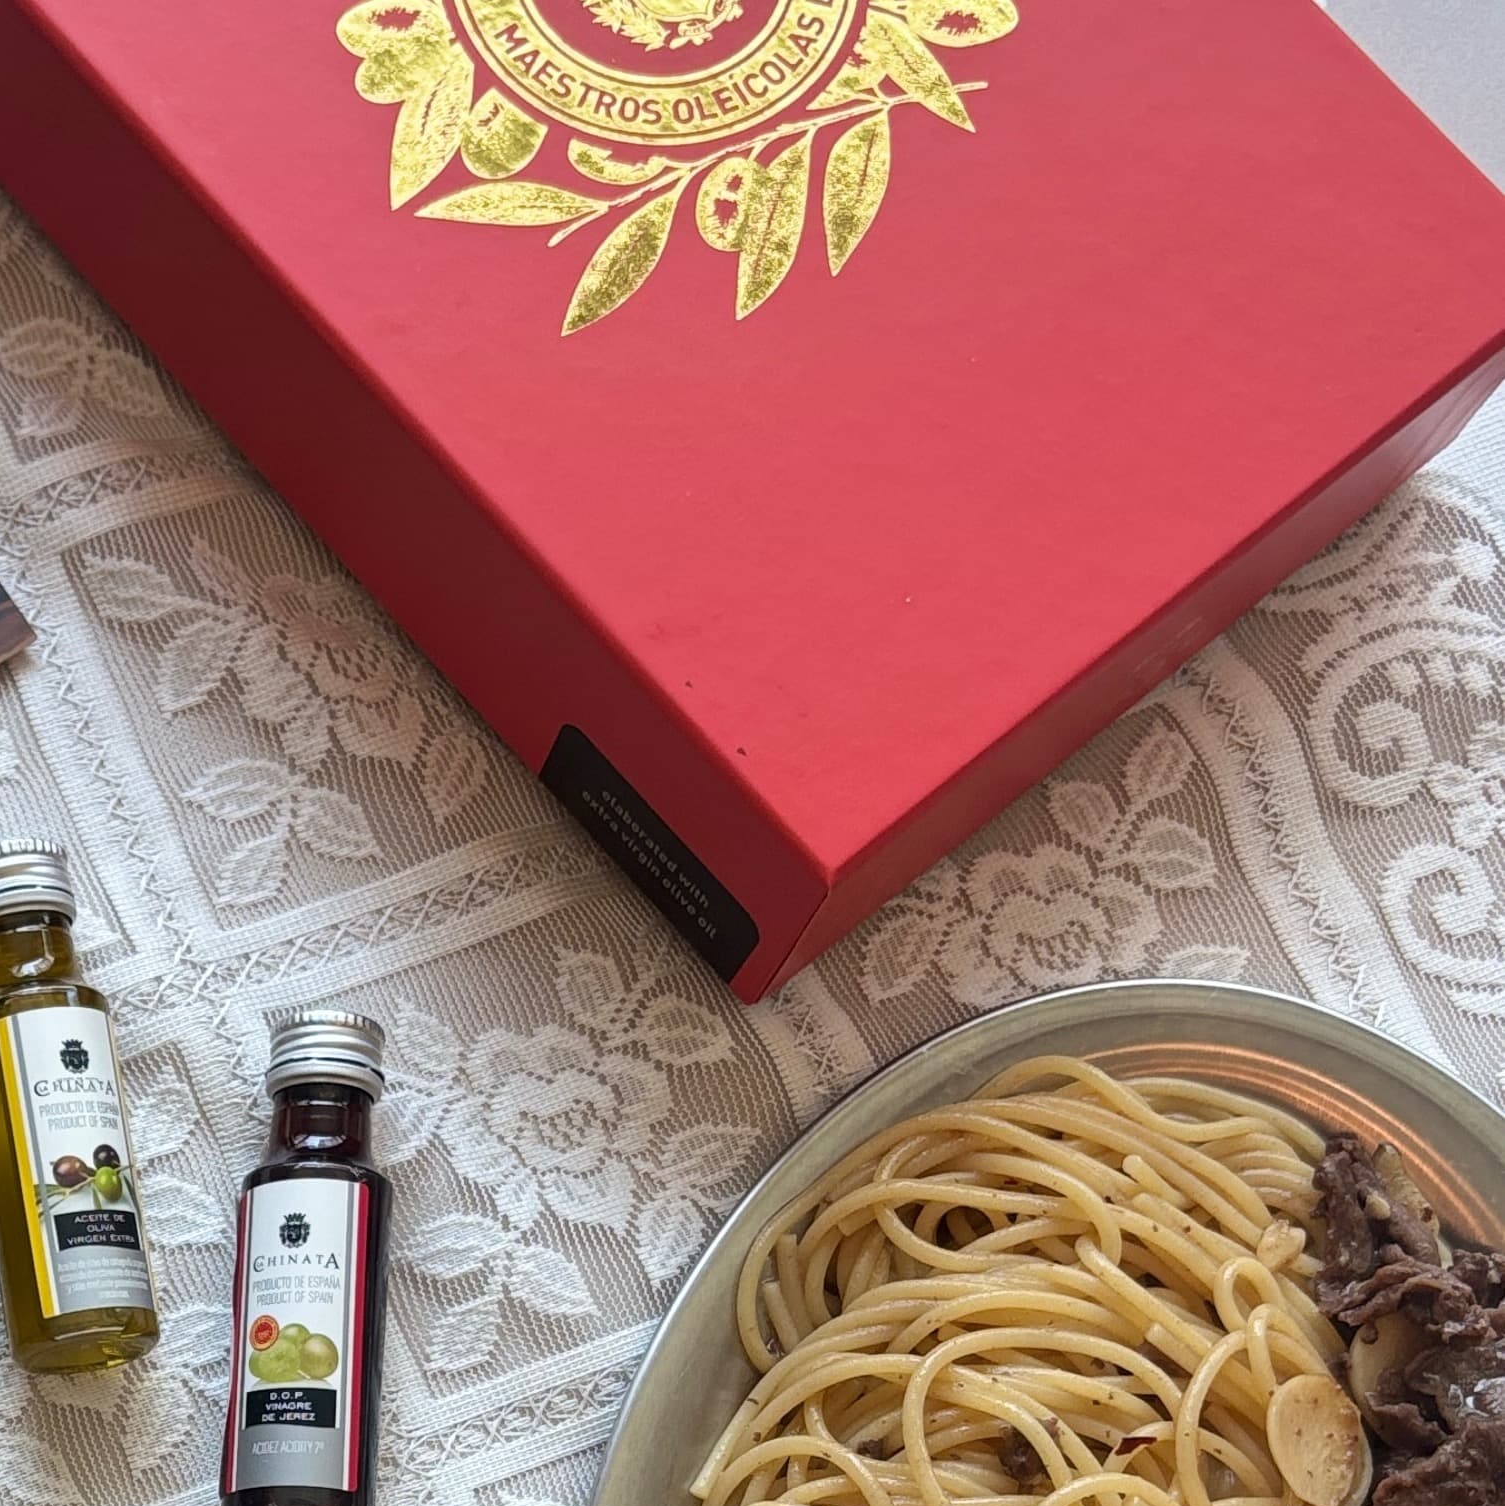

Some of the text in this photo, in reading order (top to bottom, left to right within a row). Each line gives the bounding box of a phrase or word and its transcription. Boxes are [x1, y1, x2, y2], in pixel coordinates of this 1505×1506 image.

[494, 12, 825, 125] MAESTROS OLEÍCOLAS
[601, 790, 710, 909] elaborated with
[581, 790, 718, 941] extra virgin olive oil
[74, 1214, 126, 1223] ACEITE DE
[86, 1224, 115, 1233] OLIVA
[67, 1234, 107, 1245] VIRGEN
[253, 1252, 339, 1272] CHINATA
[253, 1275, 341, 1292] PRODUCTO DE ESPAÑA
[256, 1290, 334, 1305] PRODUCT OF SPAIN
[265, 1402, 312, 1411] VINAGRE
[262, 1412, 315, 1422] DE JEREZ
